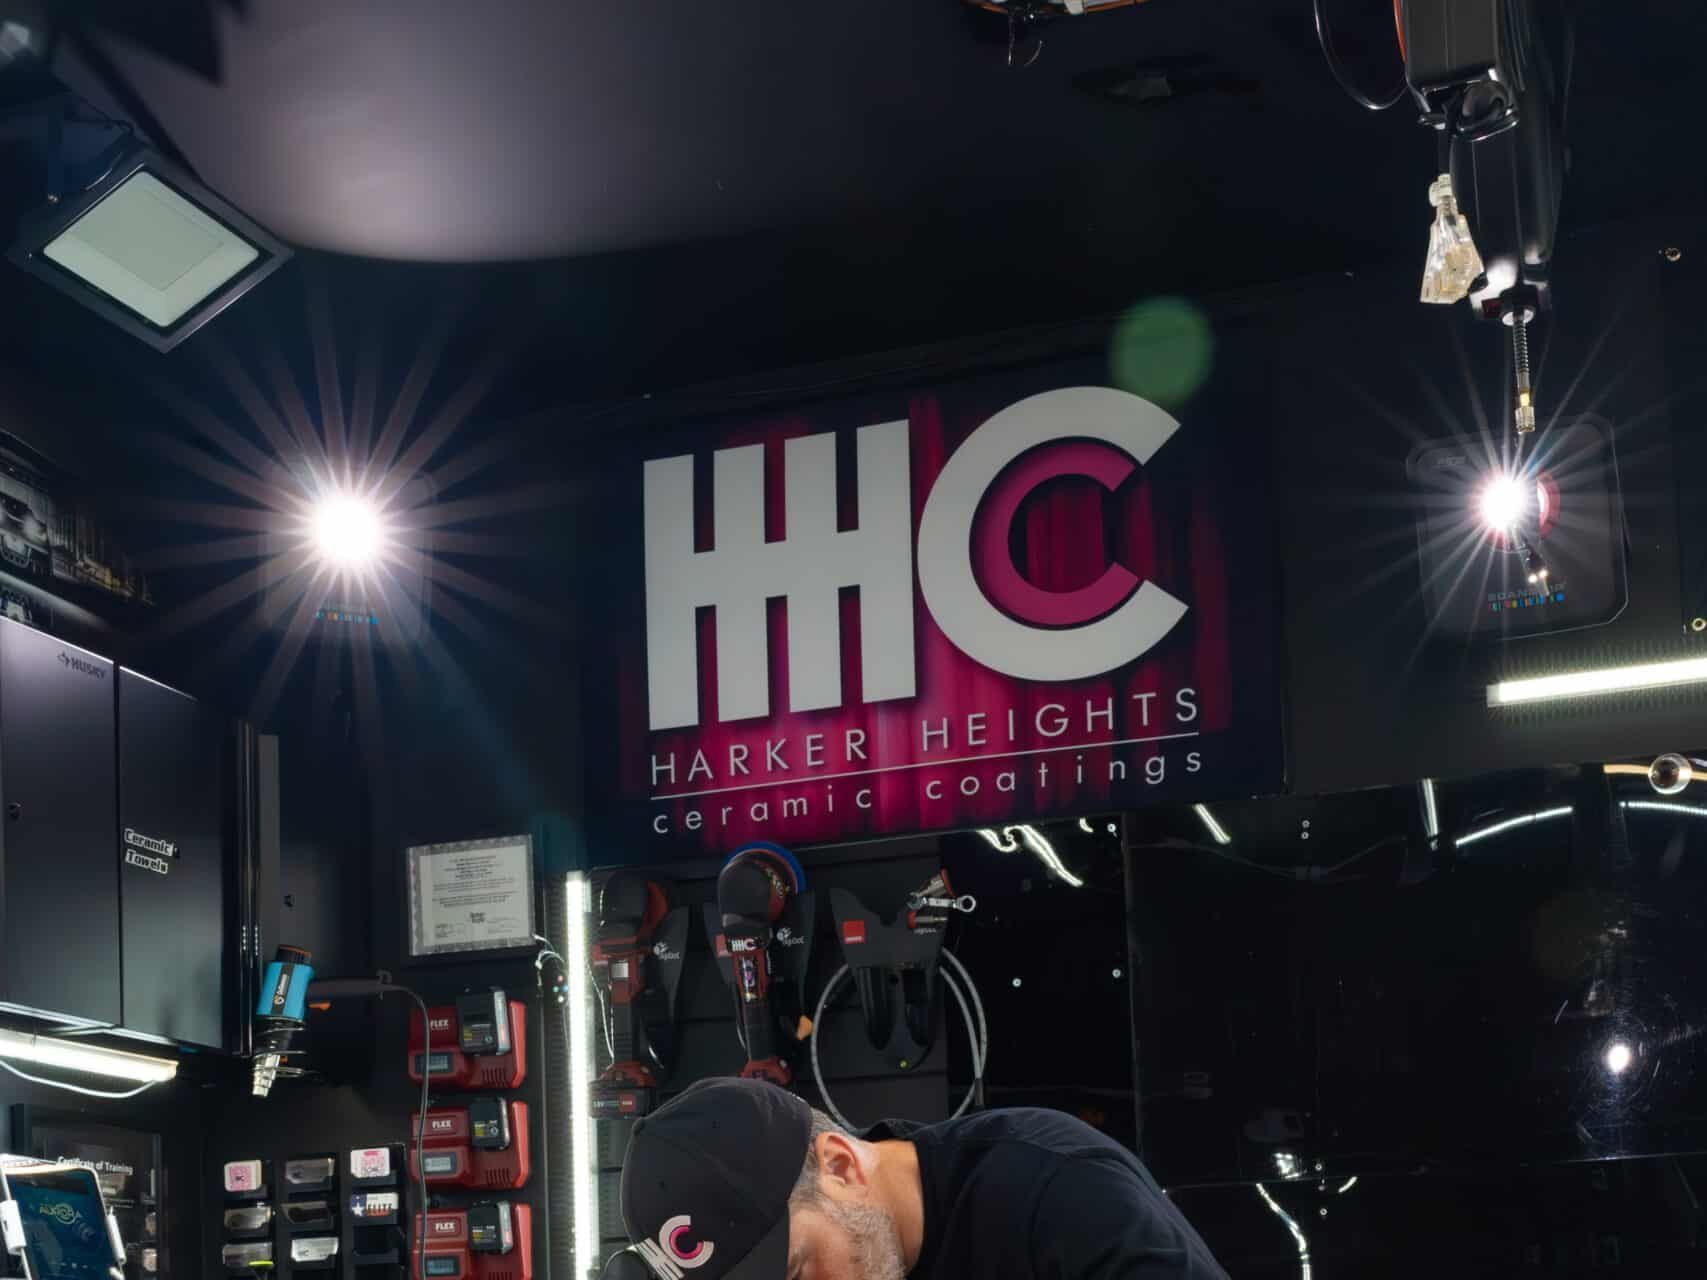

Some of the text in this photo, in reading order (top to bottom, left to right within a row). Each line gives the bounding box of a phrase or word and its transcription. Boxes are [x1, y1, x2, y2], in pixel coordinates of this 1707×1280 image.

[650, 687, 1199, 787] HARKER HEIGHTS
[653, 749, 1201, 835] ceramic coatings
[124, 828, 174, 856] Ceramic
[126, 849, 168, 874] Towels
[430, 1019, 449, 1028] FLEX
[432, 1120, 452, 1129] FLEX
[105, 1161, 134, 1176] Training
[435, 1221, 455, 1231] FLEX
